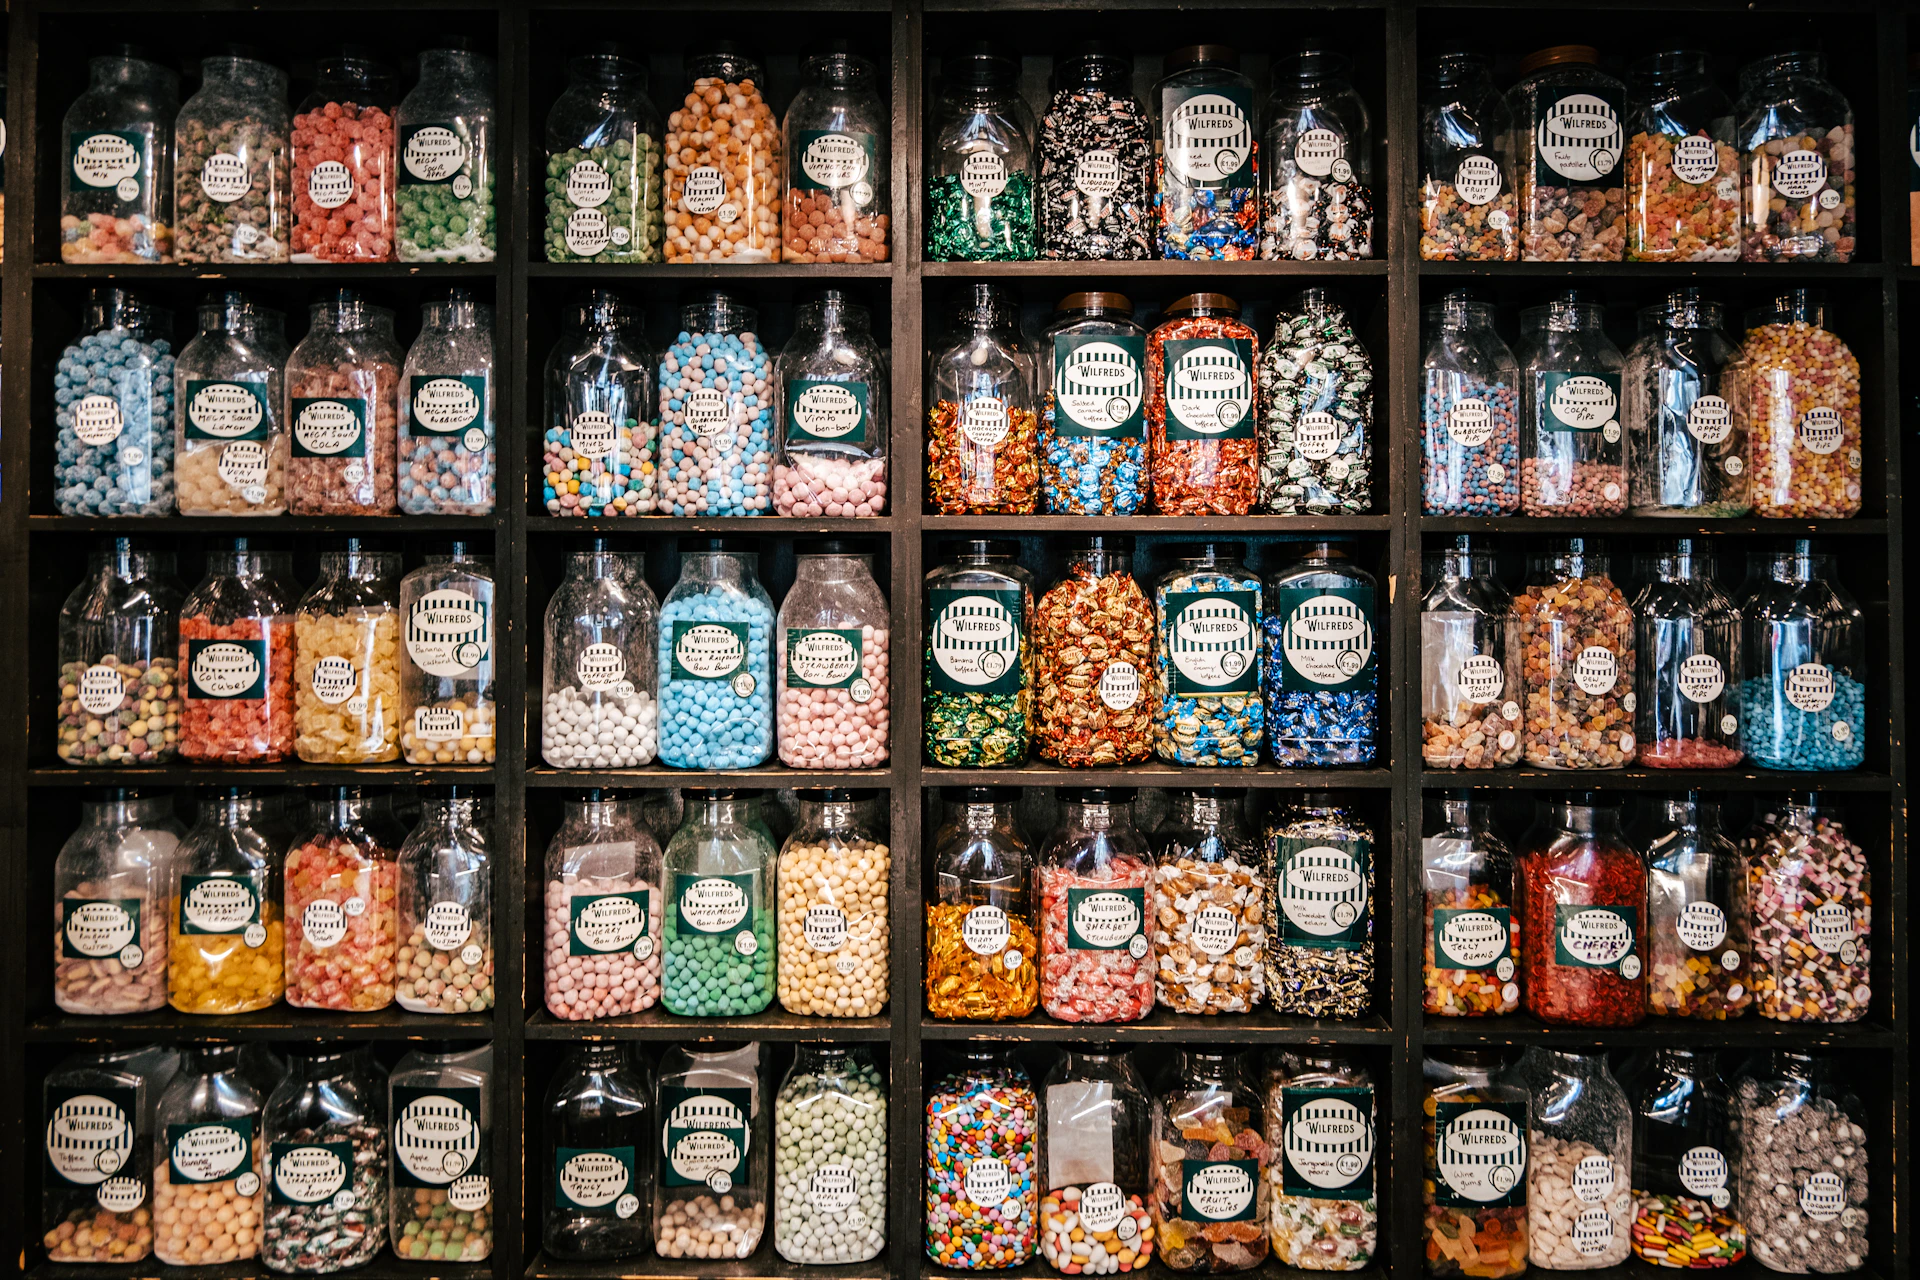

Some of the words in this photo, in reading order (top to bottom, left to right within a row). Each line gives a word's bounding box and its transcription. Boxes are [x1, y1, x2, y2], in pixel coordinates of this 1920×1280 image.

[1186, 118, 1233, 130] WILFREDS
[1560, 117, 1607, 129] WILFREDS
[87, 145, 124, 154] WILFREDS
[818, 145, 855, 154] WILFREDS
[1078, 365, 1125, 377] WILFREDS
[1187, 369, 1235, 381] WILFREDS
[427, 389, 464, 398] WILFREDS
[1567, 386, 1604, 395] WILFREDS
[205, 394, 246, 403] WILFREDS
[809, 395, 847, 404] WILFREDS
[308, 411, 345, 420] WILFREDS
[804, 413, 835, 423] Vimto
[1576, 413, 1594, 421] PIPS
[311, 440, 339, 448] COLA
[424, 612, 472, 624] WILFREDS
[952, 619, 1000, 631] WILFREDS
[1189, 621, 1238, 634] WILFREDS
[1304, 620, 1354, 631] WILFREDS
[691, 635, 729, 644] WILFREDS
[415, 644, 443, 653] Banana
[805, 642, 843, 651] WILFREDS
[206, 654, 244, 663] WILFREDS
[950, 656, 973, 664] Banana
[199, 671, 226, 681] Cola
[1300, 870, 1349, 882] WILFREDS
[200, 890, 239, 898] WILFREDS
[695, 889, 733, 898] WILFREDS
[1088, 903, 1126, 912] WILFREDS
[592, 907, 631, 918] WILFREDS
[81, 914, 118, 922] WILFREDS
[1455, 923, 1493, 932] WILFREDS
[1578, 920, 1617, 929] WILFREDS
[586, 927, 621, 936] CHERRY
[1573, 940, 1625, 950] CHERRY
[66, 1118, 113, 1131] WILFREDS
[414, 1119, 460, 1131] WILFREDS
[1305, 1121, 1355, 1134] WILFREDS
[188, 1137, 229, 1147] WILFREDS
[1458, 1133, 1507, 1146] WILFREDS
[687, 1142, 725, 1151] WILFREDS
[290, 1159, 330, 1167] WILFREDS
[575, 1164, 614, 1172] WILFREDS
[1203, 1175, 1240, 1185] WILFREDS
[1460, 1180, 1482, 1190] gums
